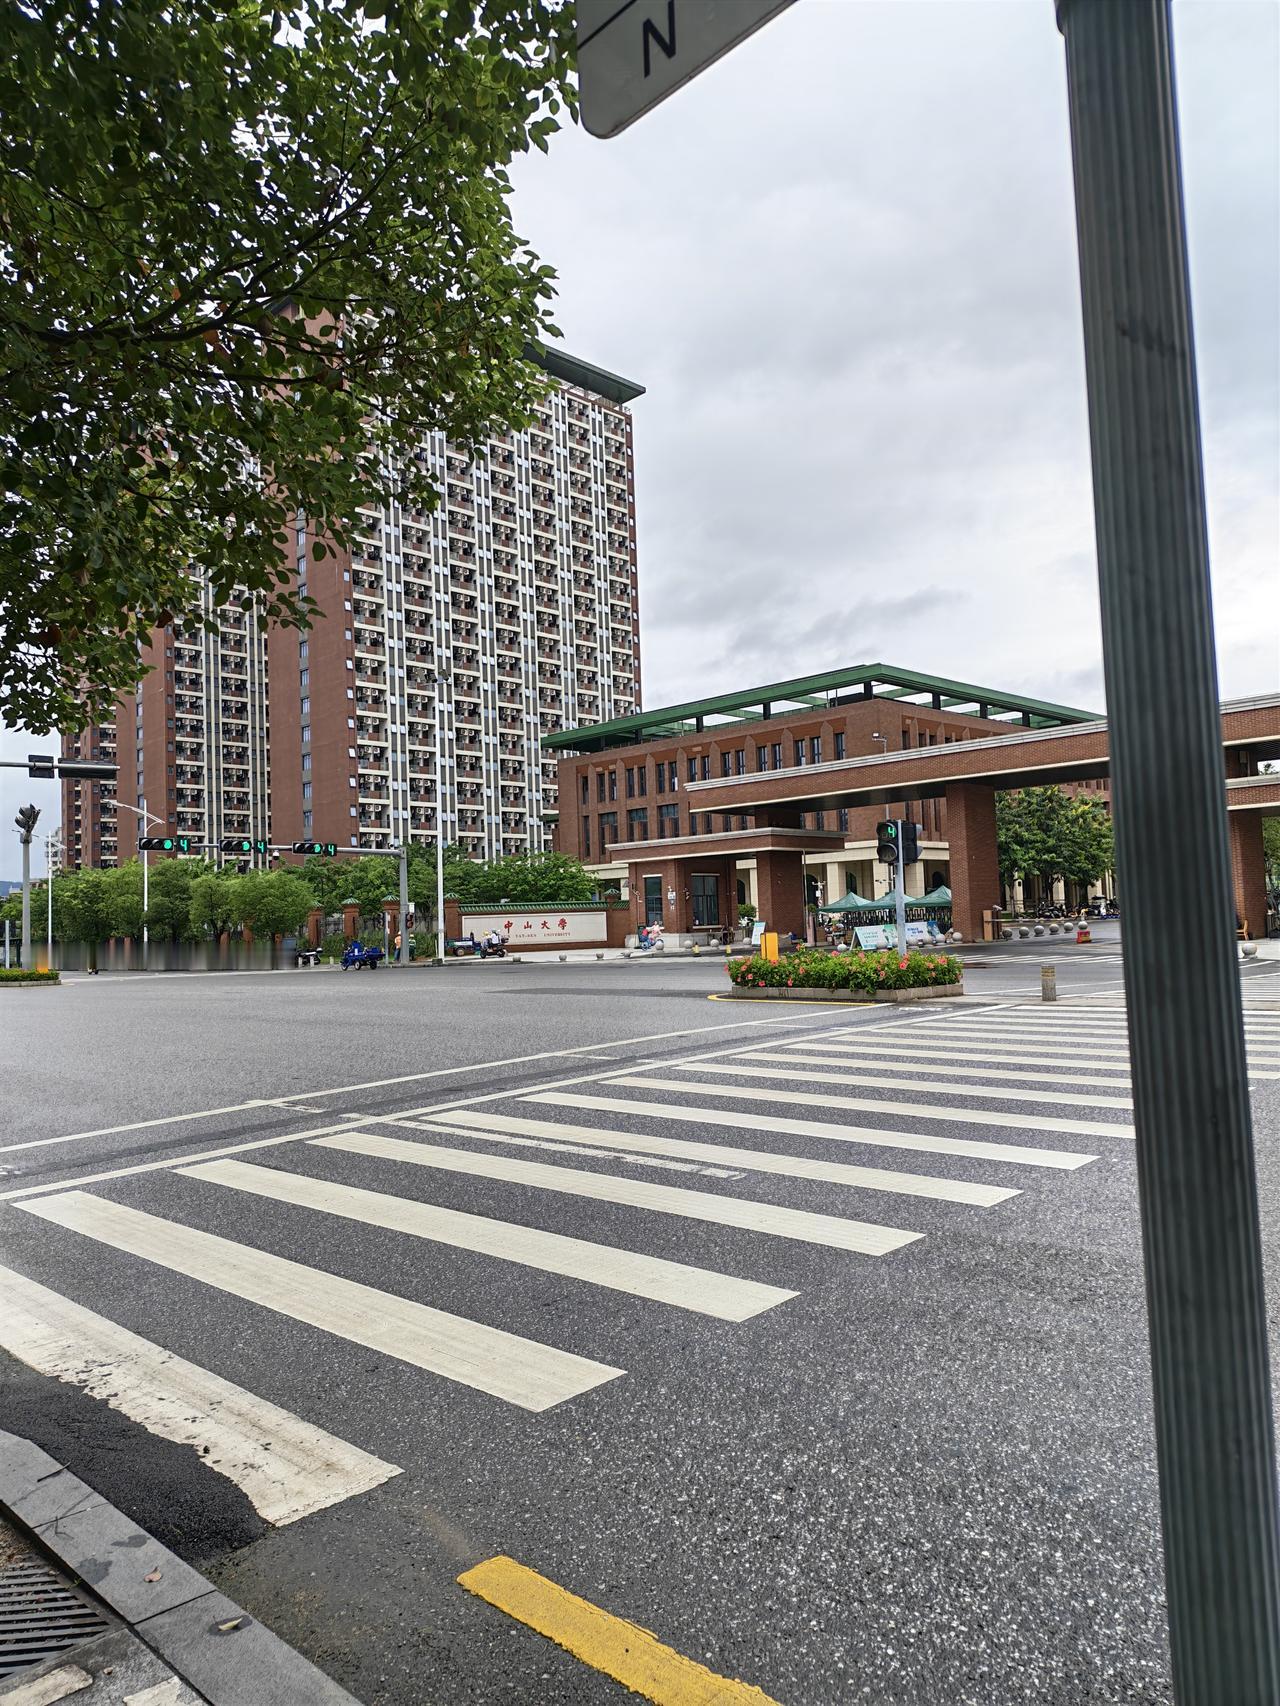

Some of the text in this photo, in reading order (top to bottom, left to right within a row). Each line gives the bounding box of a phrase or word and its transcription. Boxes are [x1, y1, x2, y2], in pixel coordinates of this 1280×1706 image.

[643, 0, 676, 78] N
[888, 826, 895, 838] 4
[180, 839, 188, 851] 4
[258, 841, 264, 852] 4
[328, 844, 335, 854] 4
